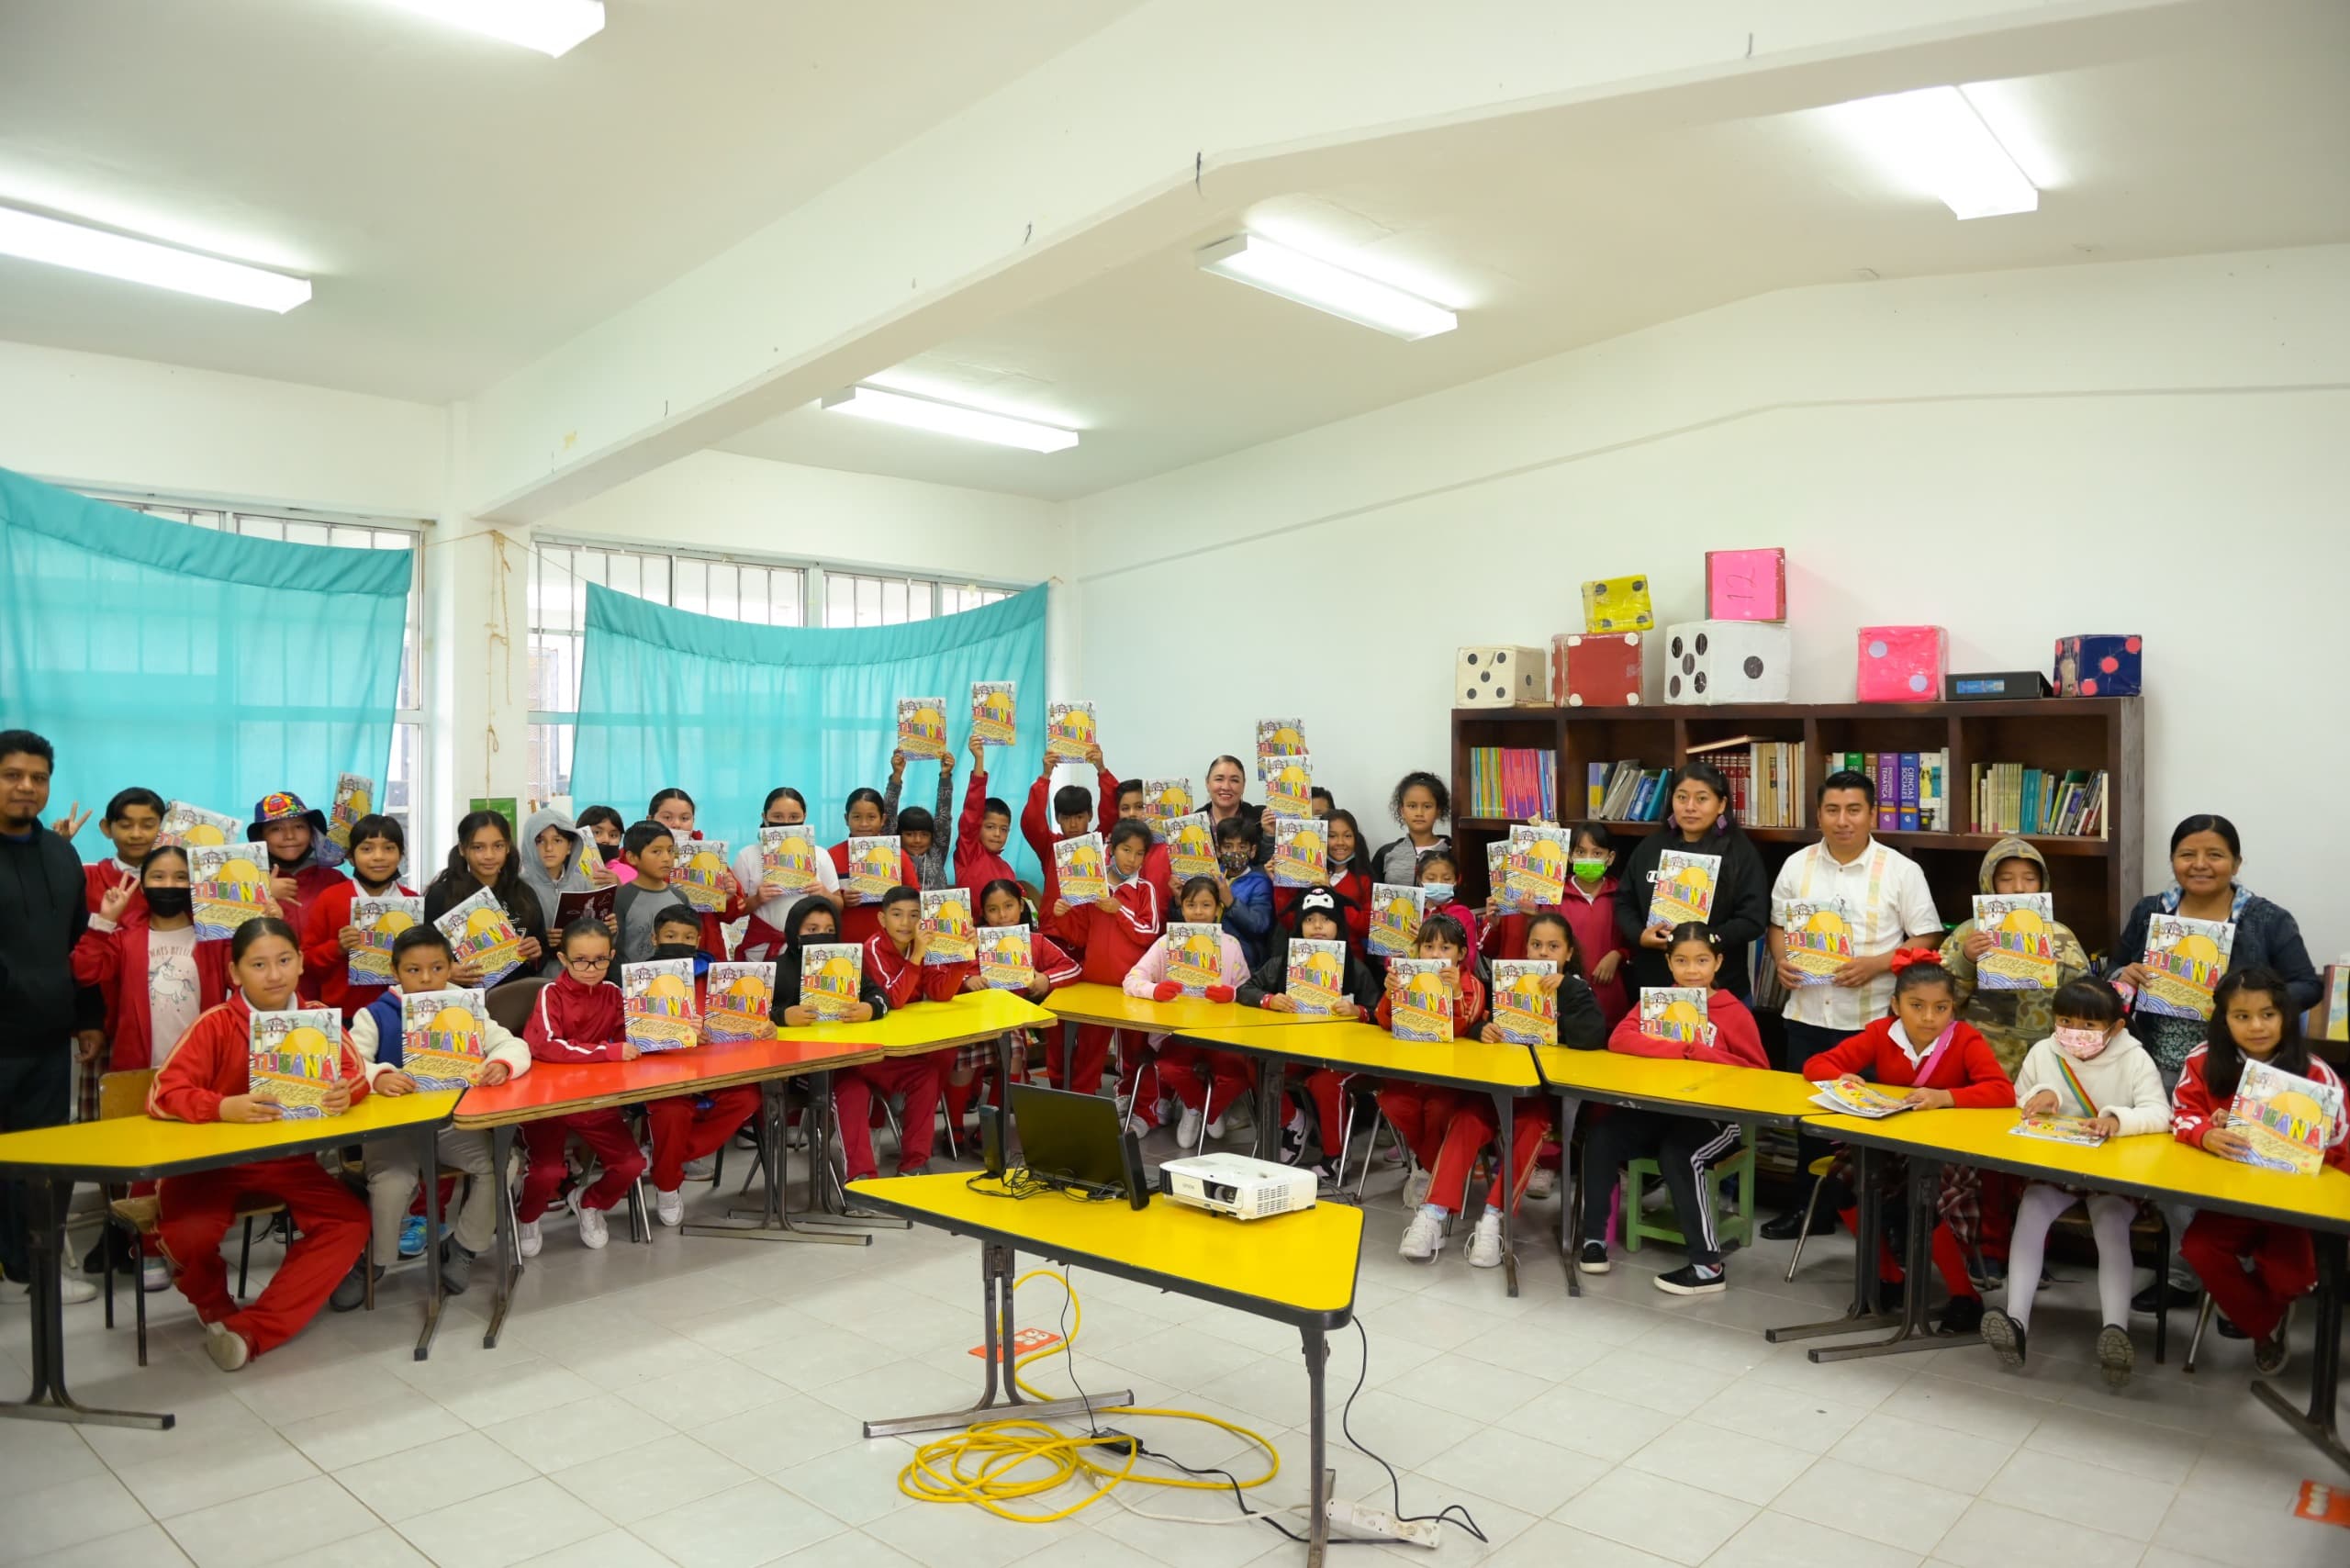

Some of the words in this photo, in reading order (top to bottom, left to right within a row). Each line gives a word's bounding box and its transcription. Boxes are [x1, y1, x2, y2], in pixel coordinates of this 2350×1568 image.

[972, 706, 1014, 726] TIJUANA
[899, 722, 945, 741] TIJUANA
[1048, 724, 1094, 745] TIJUANA
[1258, 742, 1309, 756] TIJUANA
[1267, 780, 1310, 801] TIJUANA
[1167, 842, 1214, 857] TIJUANA
[1272, 844, 1323, 868] TIJUANA
[763, 853, 816, 872] TIJUANA
[850, 861, 901, 881] TIJUANA
[1057, 861, 1105, 878] TIJUANA
[1508, 854, 1564, 882] TIJUANA
[671, 866, 726, 890] TIJUANA
[195, 881, 266, 905] TIJUANA
[1653, 879, 1712, 911] TIJUANA
[455, 922, 518, 958] TIJUANA
[1785, 932, 1854, 957] TIJUANA
[978, 951, 1031, 969] TIJUANA
[1166, 948, 1221, 973] TIJUANA
[2144, 949, 2221, 990] TIJUANA
[801, 973, 860, 998] TIJUANA
[1289, 966, 1341, 992] TIJUANA
[623, 995, 697, 1021] TIJUANA
[706, 992, 770, 1023] TIJUANA
[1392, 988, 1450, 1016] TIJUANA
[1494, 991, 1556, 1019] TIJUANA
[405, 1030, 484, 1057] TIJUANA
[1640, 1019, 1709, 1045] TIJUANA
[252, 1053, 341, 1082] TIJUANA
[2236, 1095, 2325, 1148] TIJUANA
